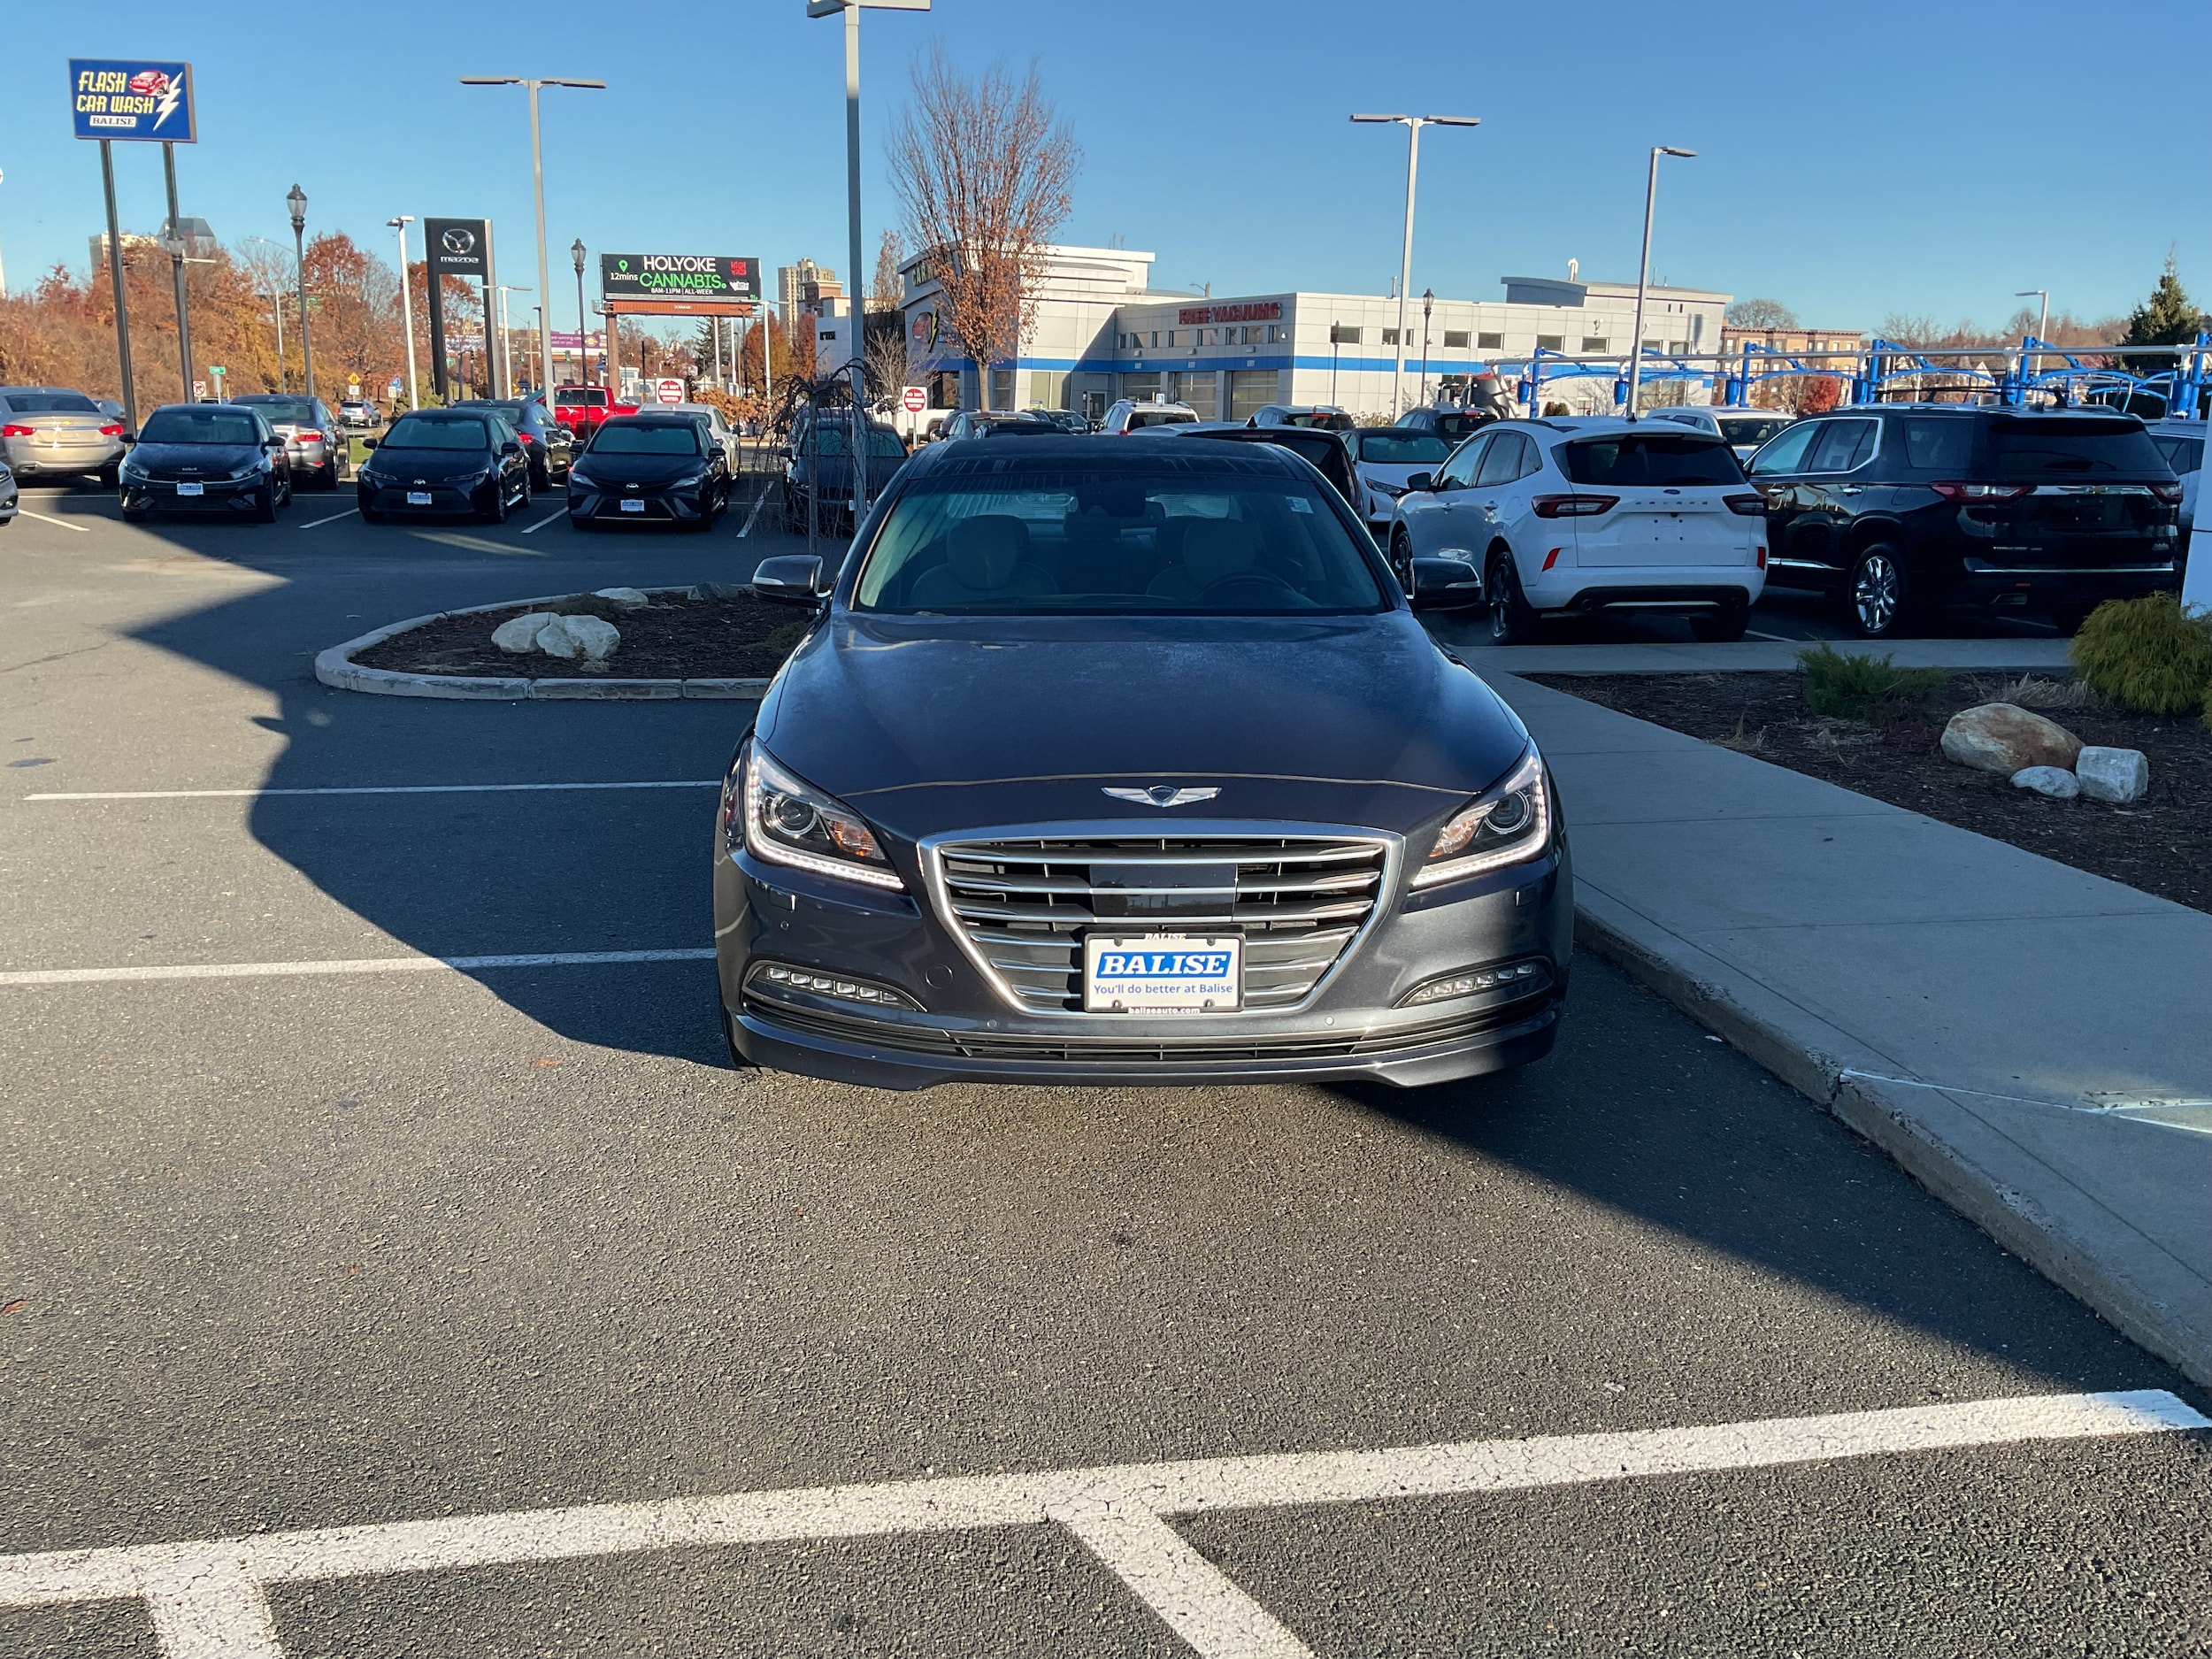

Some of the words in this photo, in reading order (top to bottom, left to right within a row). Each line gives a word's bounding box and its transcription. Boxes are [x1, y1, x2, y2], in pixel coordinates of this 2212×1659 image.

[78, 71, 127, 93] FLASH
[76, 95, 107, 112] CAR
[110, 96, 154, 113] WASH
[643, 256, 716, 272] HOLYOKE
[611, 273, 638, 281] 12mins
[1179, 307, 1210, 325] FREE
[1211, 302, 1281, 322] VACUUMS
[1101, 955, 1227, 975] BALISE
[1094, 984, 1125, 995] You'll
[1127, 984, 1141, 994] do
[1145, 984, 1181, 994] better
[1199, 983, 1233, 994] Balise
[1128, 1006, 1201, 1015] baliseauto.com
